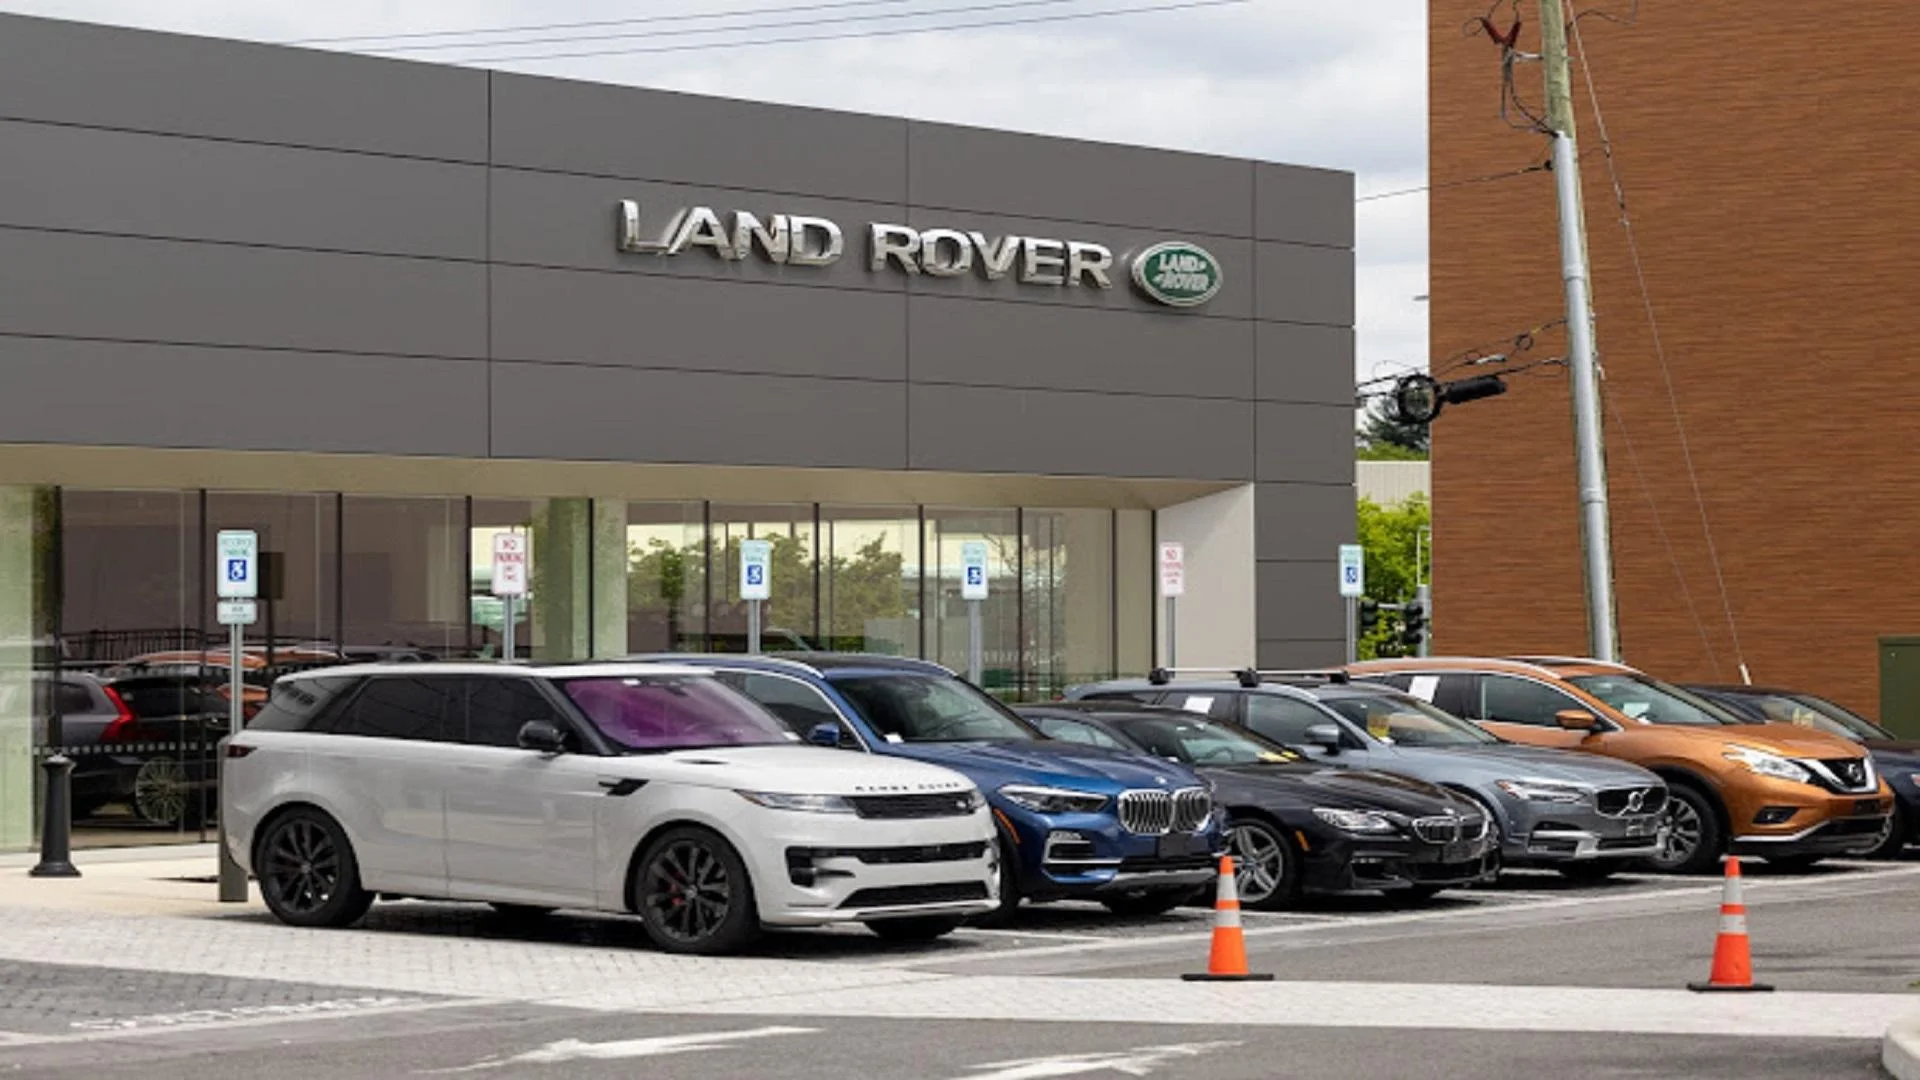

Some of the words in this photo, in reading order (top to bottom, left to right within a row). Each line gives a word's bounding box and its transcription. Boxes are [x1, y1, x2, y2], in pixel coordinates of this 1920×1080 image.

[618, 199, 843, 266] LAND
[869, 221, 1112, 288] ROVER
[1159, 253, 1199, 272] LAND
[1159, 271, 1209, 291] ROVER
